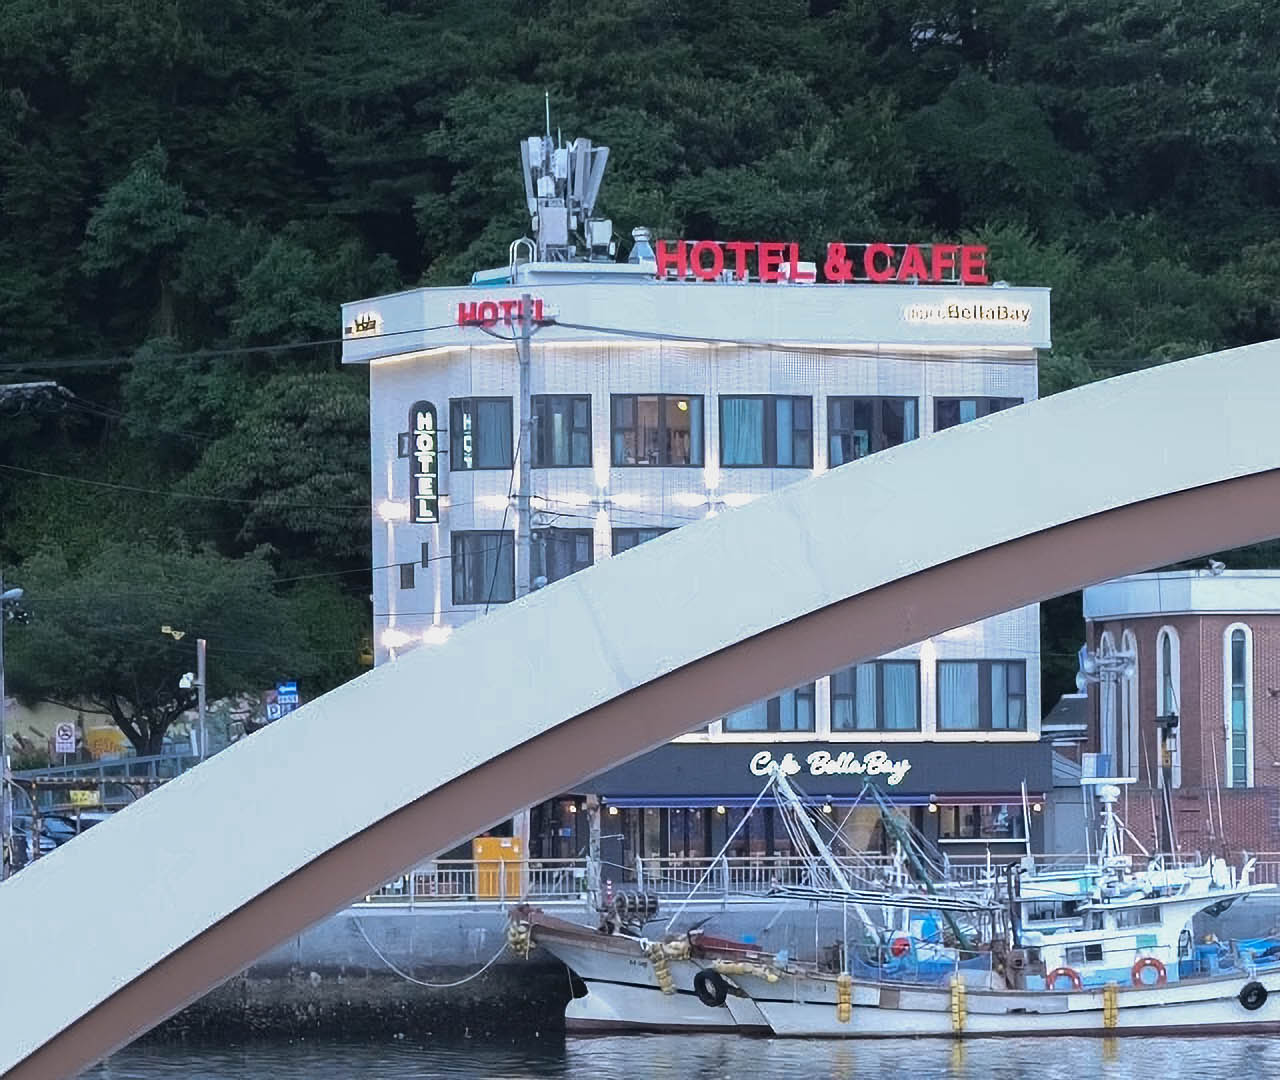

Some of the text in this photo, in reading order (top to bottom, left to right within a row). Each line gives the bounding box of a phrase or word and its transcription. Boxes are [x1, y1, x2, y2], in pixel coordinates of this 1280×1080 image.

[656, 240, 988, 284] HOTEL & CAFE
[415, 411, 435, 519] HOTEL
